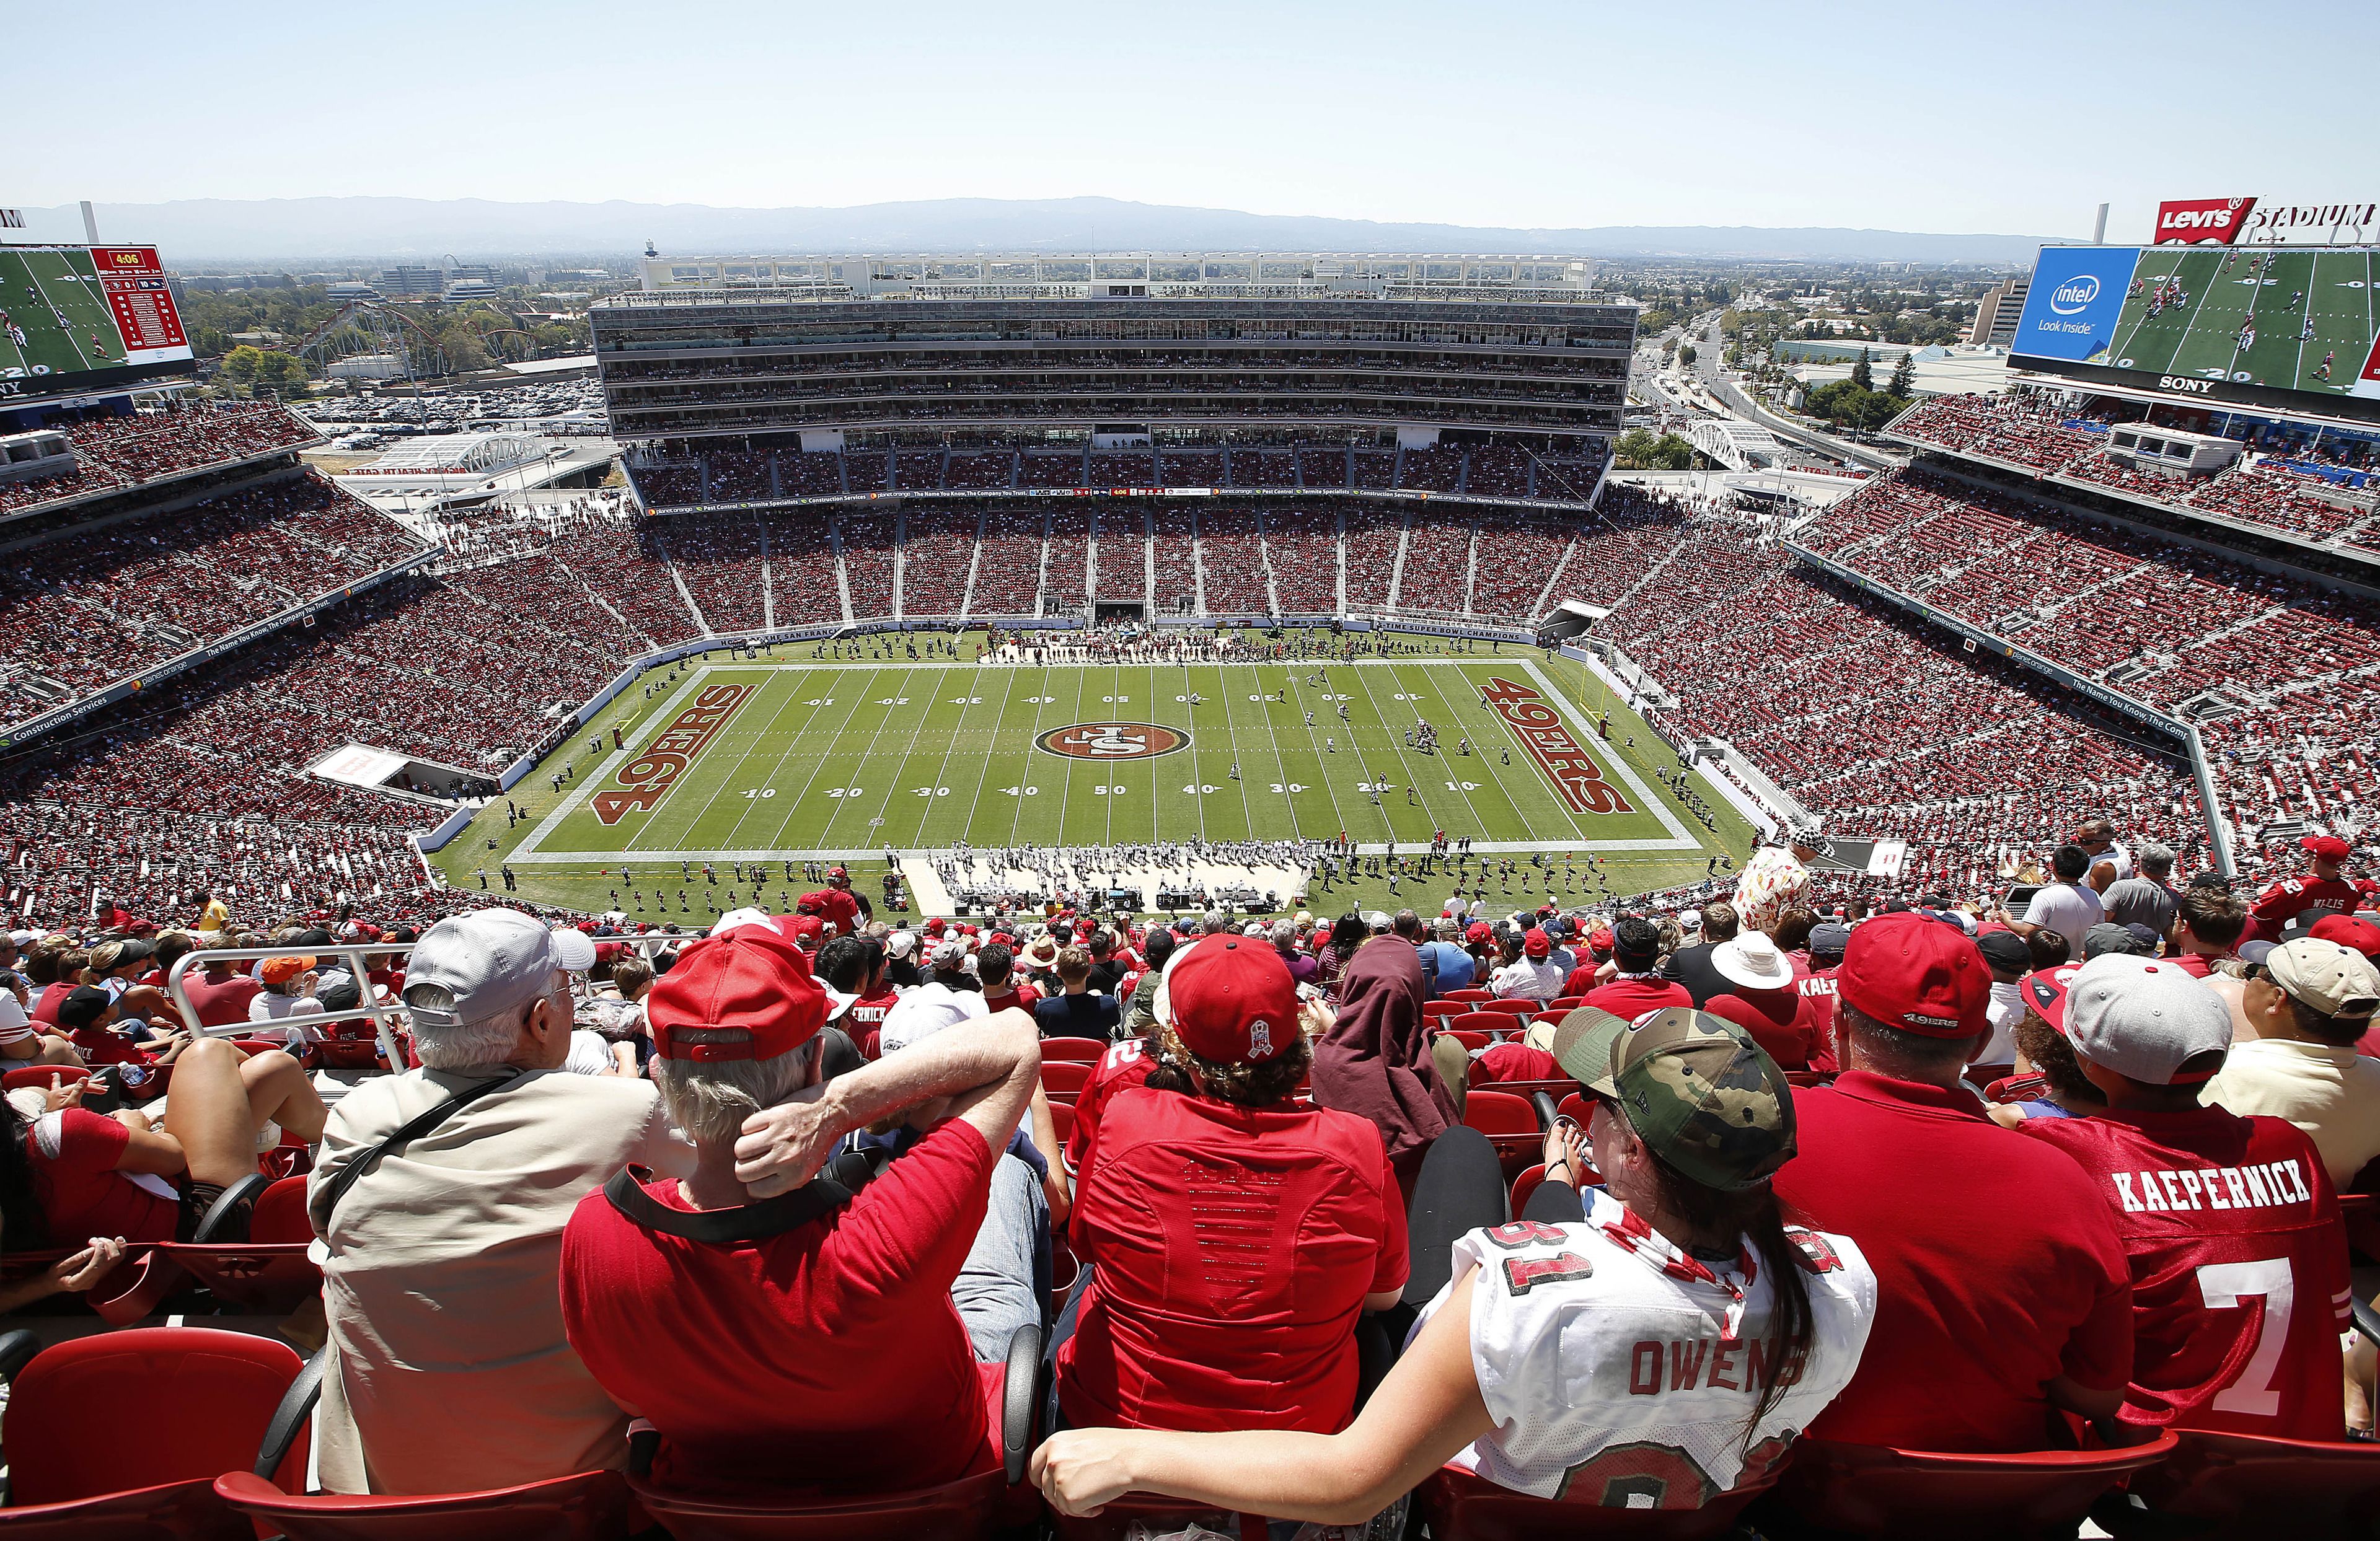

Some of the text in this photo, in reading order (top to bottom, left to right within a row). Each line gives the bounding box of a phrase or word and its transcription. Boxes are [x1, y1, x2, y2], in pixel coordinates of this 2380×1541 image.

[2243, 203, 2377, 228] STADIUM
[116, 254, 139, 264] 4:06
[2057, 283, 2092, 303] intel
[2038, 319, 2061, 332] Look
[2158, 375, 2216, 394] SONY
[808, 496, 844, 504] Construction
[1532, 501, 1559, 509] Company
[1823, 562, 1848, 578] Pest Control
[1866, 581, 1907, 606] Termite Specialists
[206, 599, 330, 657] The Name You Know, The Company You Trust.
[1409, 625, 1437, 633] SUPER
[1440, 628, 1464, 636] BOWL
[1466, 630, 1520, 640] CHAMPIONS
[1929, 612, 1986, 644] Construction Services
[2072, 678, 2086, 692] The
[2086, 685, 2109, 702] Name
[2109, 695, 2123, 708] You
[2123, 703, 2148, 721] Know,
[2149, 714, 2164, 727] The
[14, 696, 108, 742] Construction Services
[1480, 676, 1637, 815] 49ERS
[588, 683, 759, 827] 49ERS
[744, 788, 776, 799] 10
[828, 788, 863, 798] 20
[917, 786, 951, 797] 30
[1005, 786, 1039, 796] 40
[1095, 785, 1126, 796] 50
[1183, 784, 1215, 794] 40
[1269, 783, 1303, 793] 30
[1445, 781, 1476, 791] 10
[1902, 1012, 1959, 1029] 49ERS
[2111, 1159, 2311, 1213] KAEPERNICK
[2195, 1257, 2294, 1416] 7
[1628, 1335, 1811, 1396] OWENS
